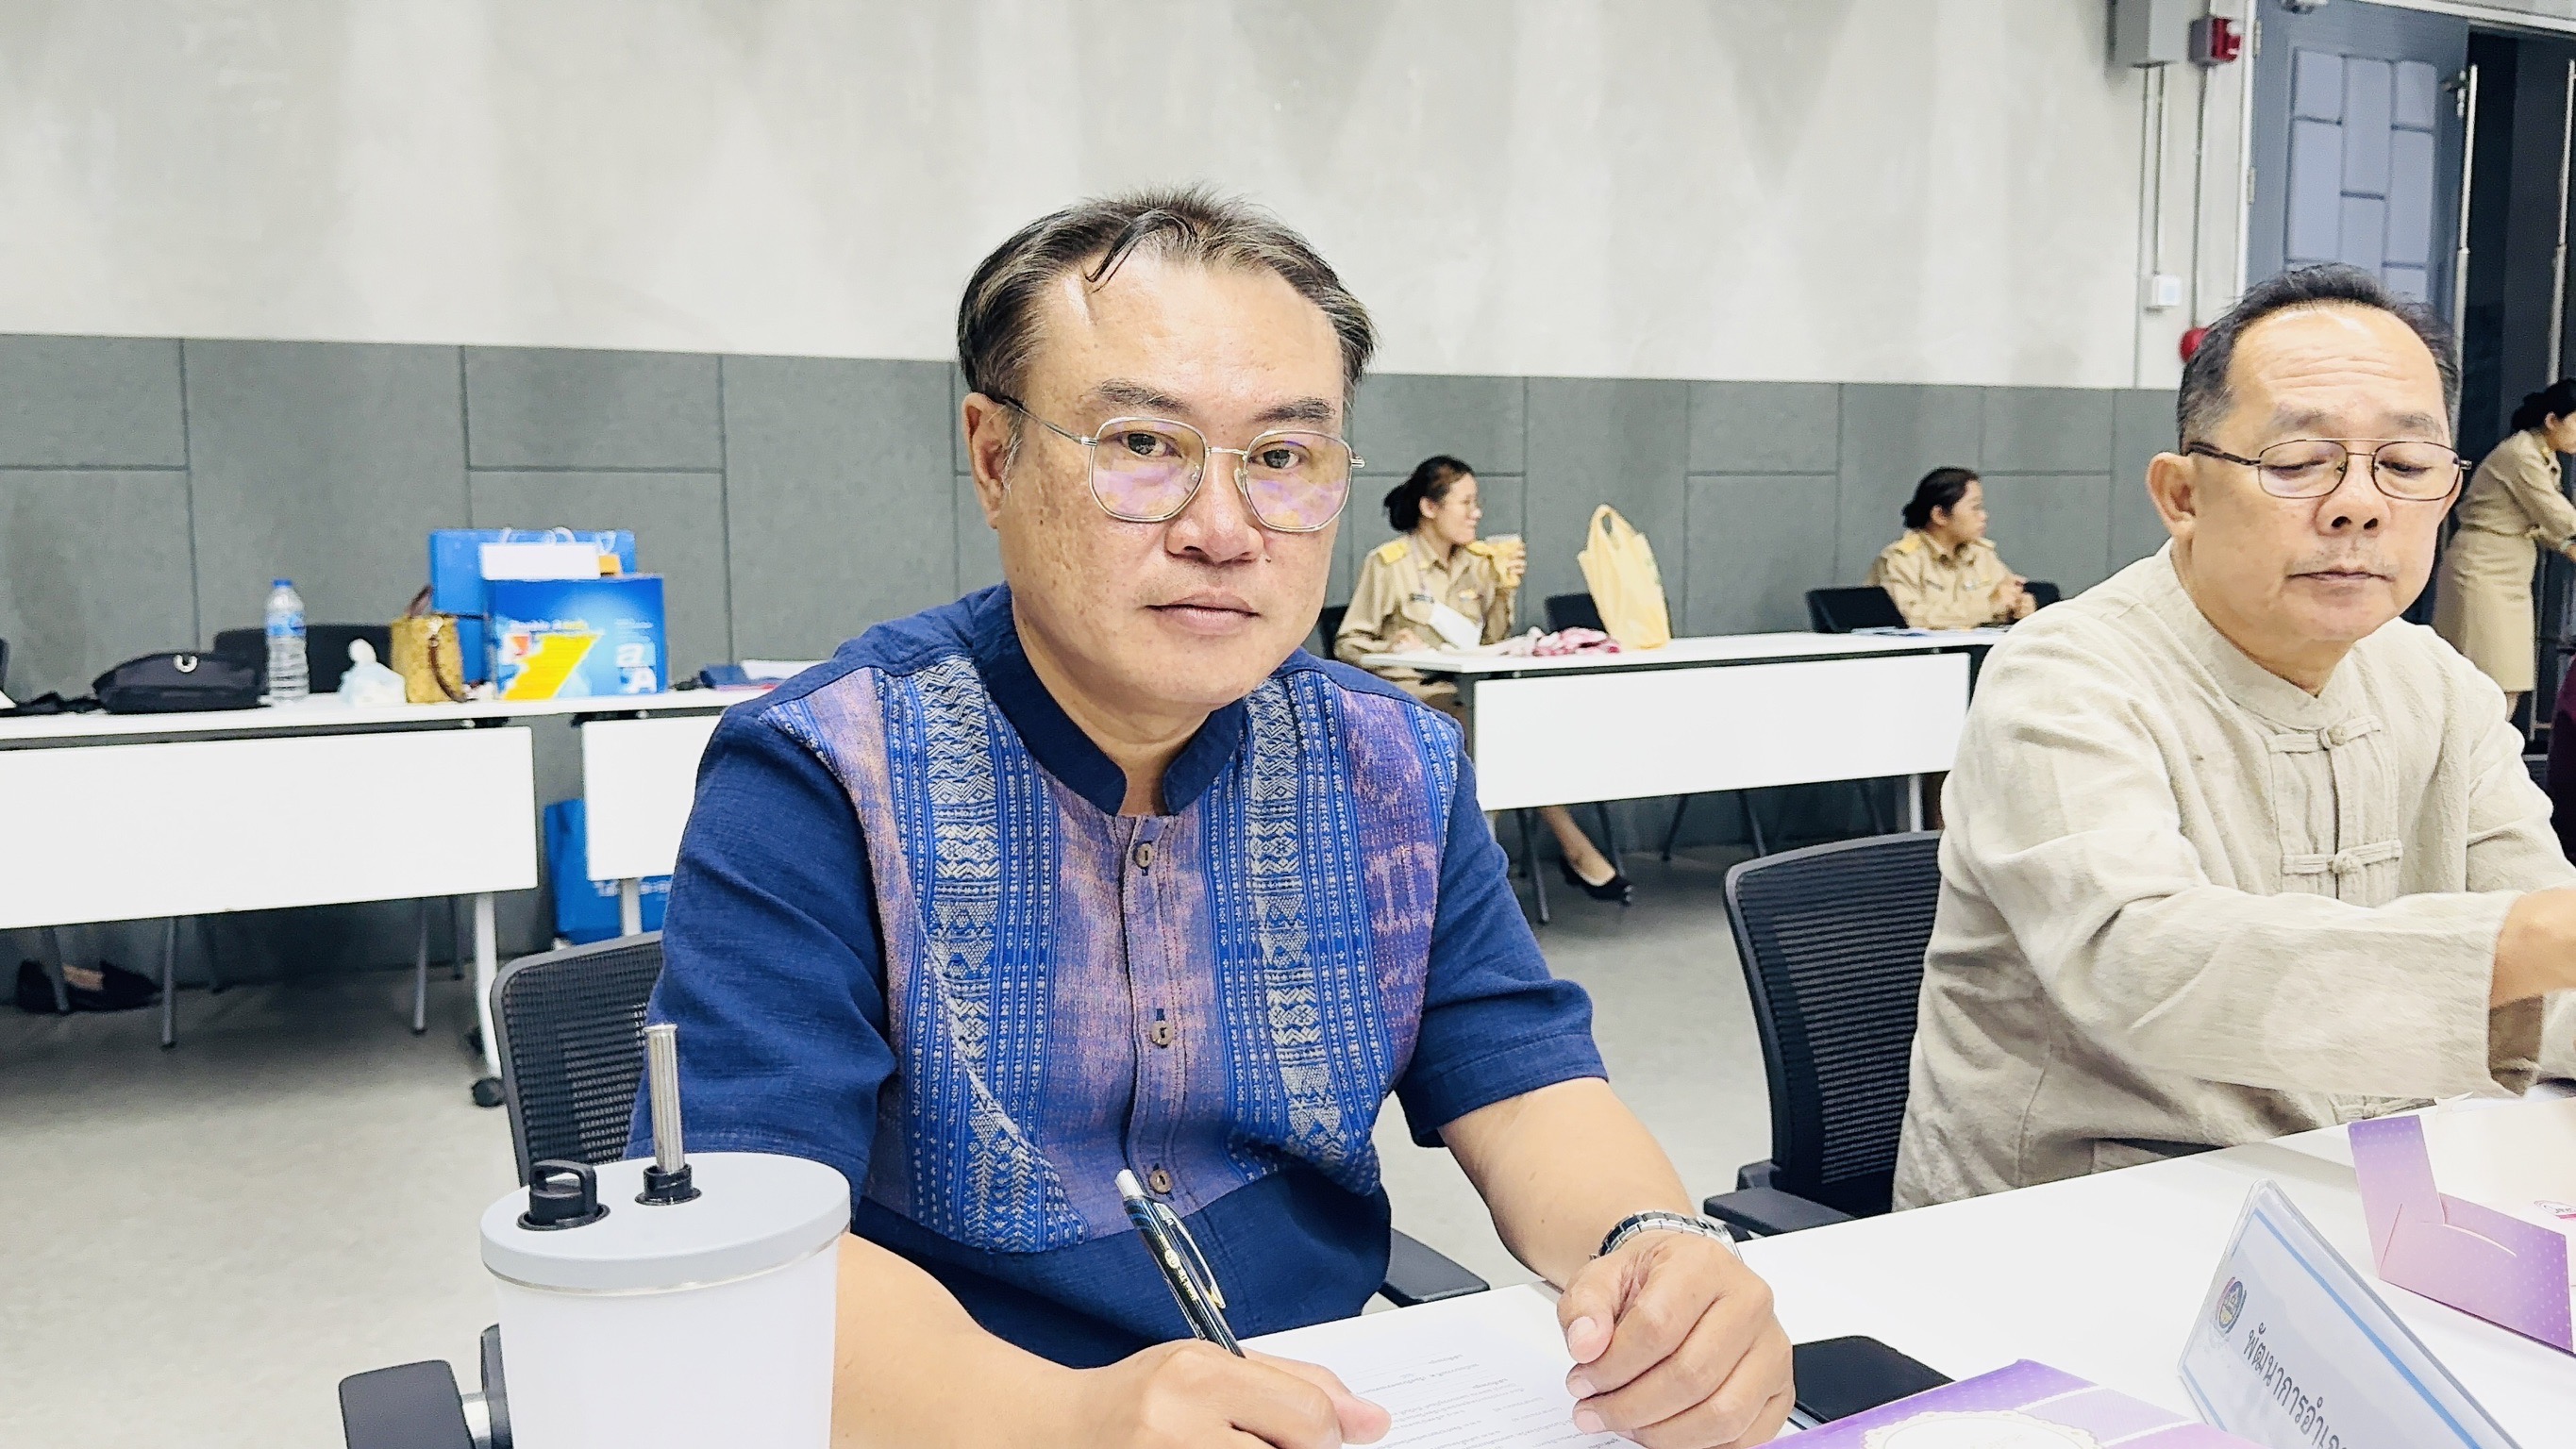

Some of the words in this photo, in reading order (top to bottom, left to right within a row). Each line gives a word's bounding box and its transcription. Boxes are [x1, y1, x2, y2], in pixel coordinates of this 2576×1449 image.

[2243, 1321, 2348, 1449] พัฒนาการอำเ
